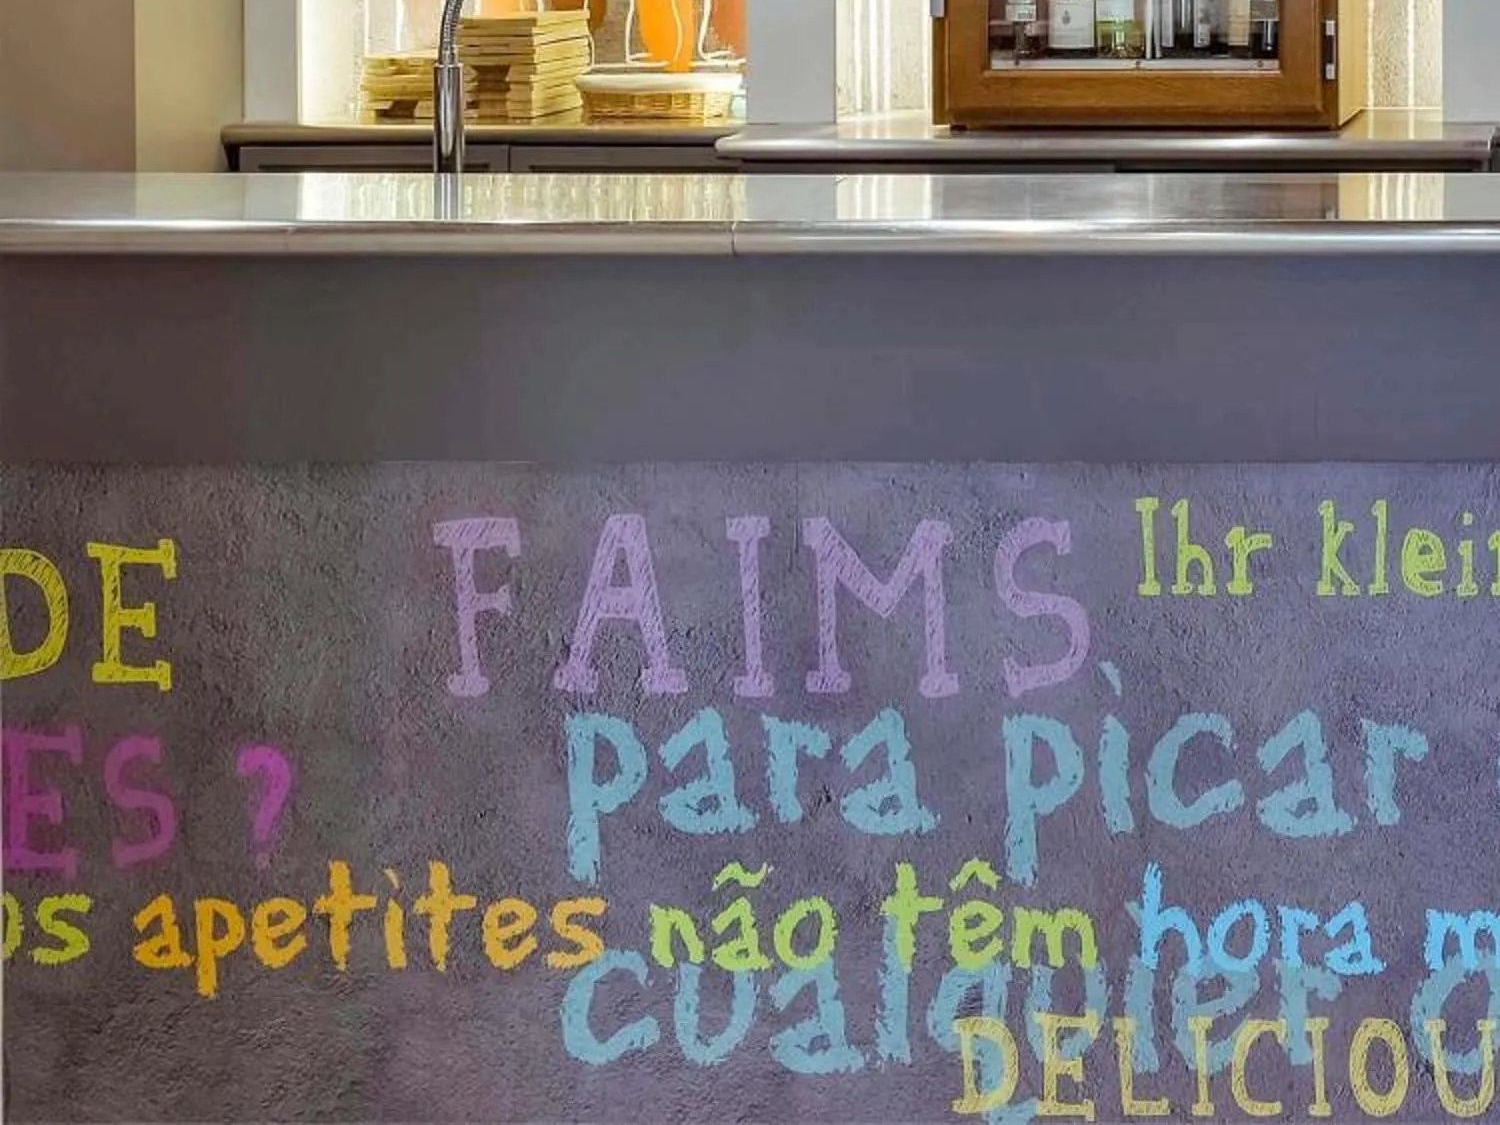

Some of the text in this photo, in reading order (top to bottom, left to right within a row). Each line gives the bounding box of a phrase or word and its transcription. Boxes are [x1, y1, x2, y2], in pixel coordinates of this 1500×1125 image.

[433, 513, 1091, 698] FAIMS
[1135, 497, 1272, 597] Ihr
[564, 707, 940, 885] para
[133, 860, 608, 1000] apetites
[650, 861, 838, 972] não
[878, 857, 1098, 972] têm
[1138, 861, 1387, 975] hora
